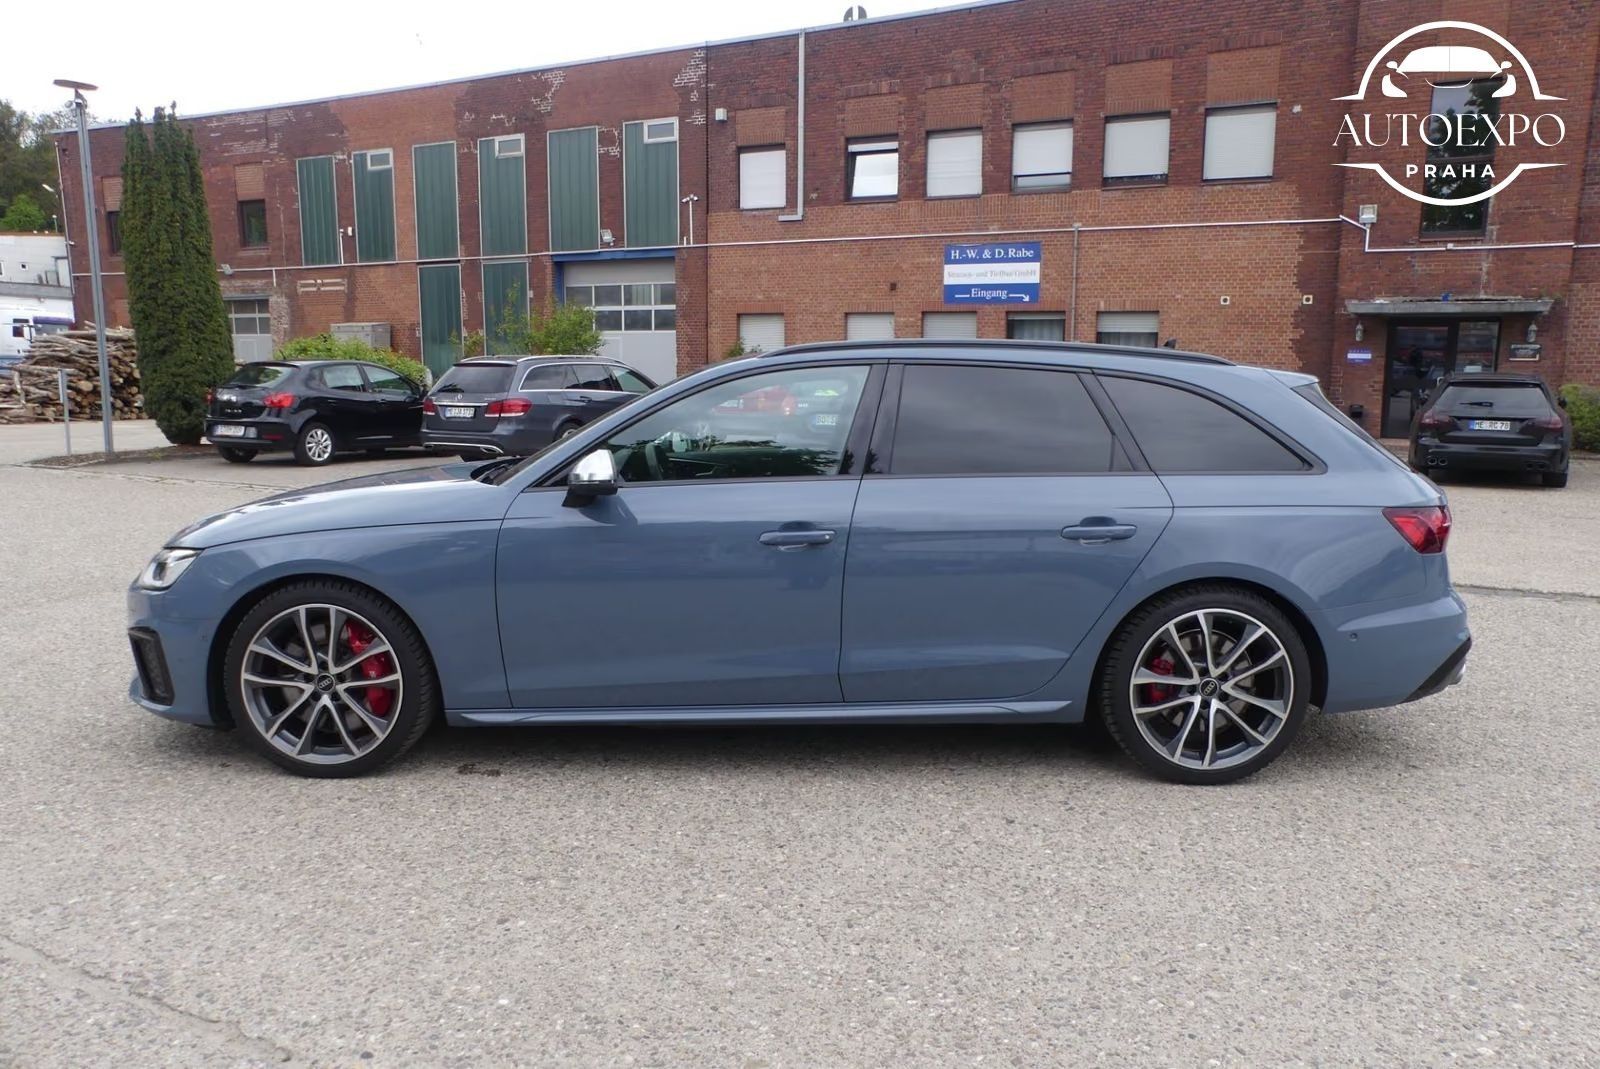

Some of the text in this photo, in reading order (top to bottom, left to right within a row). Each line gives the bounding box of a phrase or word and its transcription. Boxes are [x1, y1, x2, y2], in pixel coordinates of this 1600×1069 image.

[951, 249, 979, 259] H.-W.
[982, 249, 991, 259] &
[1008, 248, 1034, 258] Rabe
[971, 288, 1008, 300] Eingang
